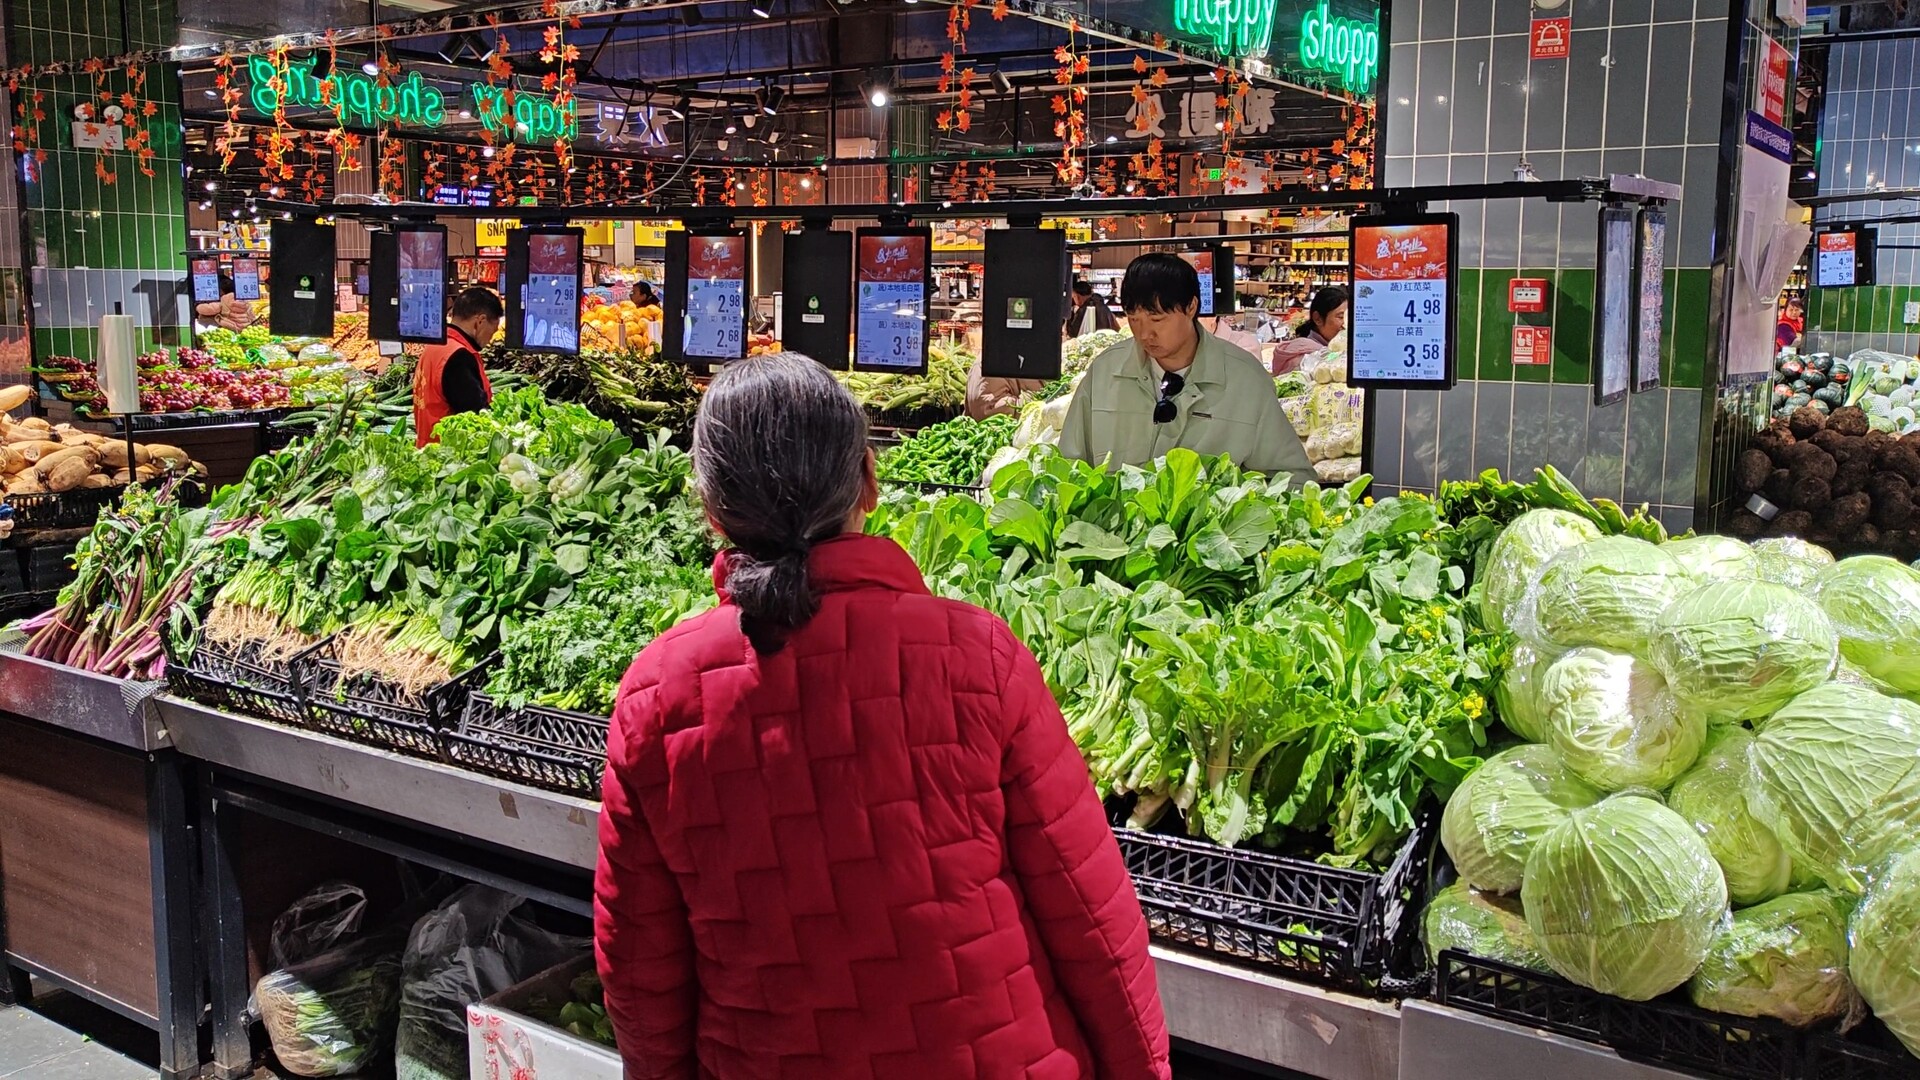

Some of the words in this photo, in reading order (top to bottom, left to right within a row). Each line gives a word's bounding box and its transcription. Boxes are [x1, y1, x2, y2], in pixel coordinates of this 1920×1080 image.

[554, 288, 574, 306] 2.98
[718, 294, 741, 313] 2.98
[1404, 299, 1441, 323] 4.98
[423, 313, 440, 329] 6.98
[717, 329, 739, 348] 2.68
[893, 336, 919, 356] 3.98
[1403, 344, 1440, 368] 3.58
